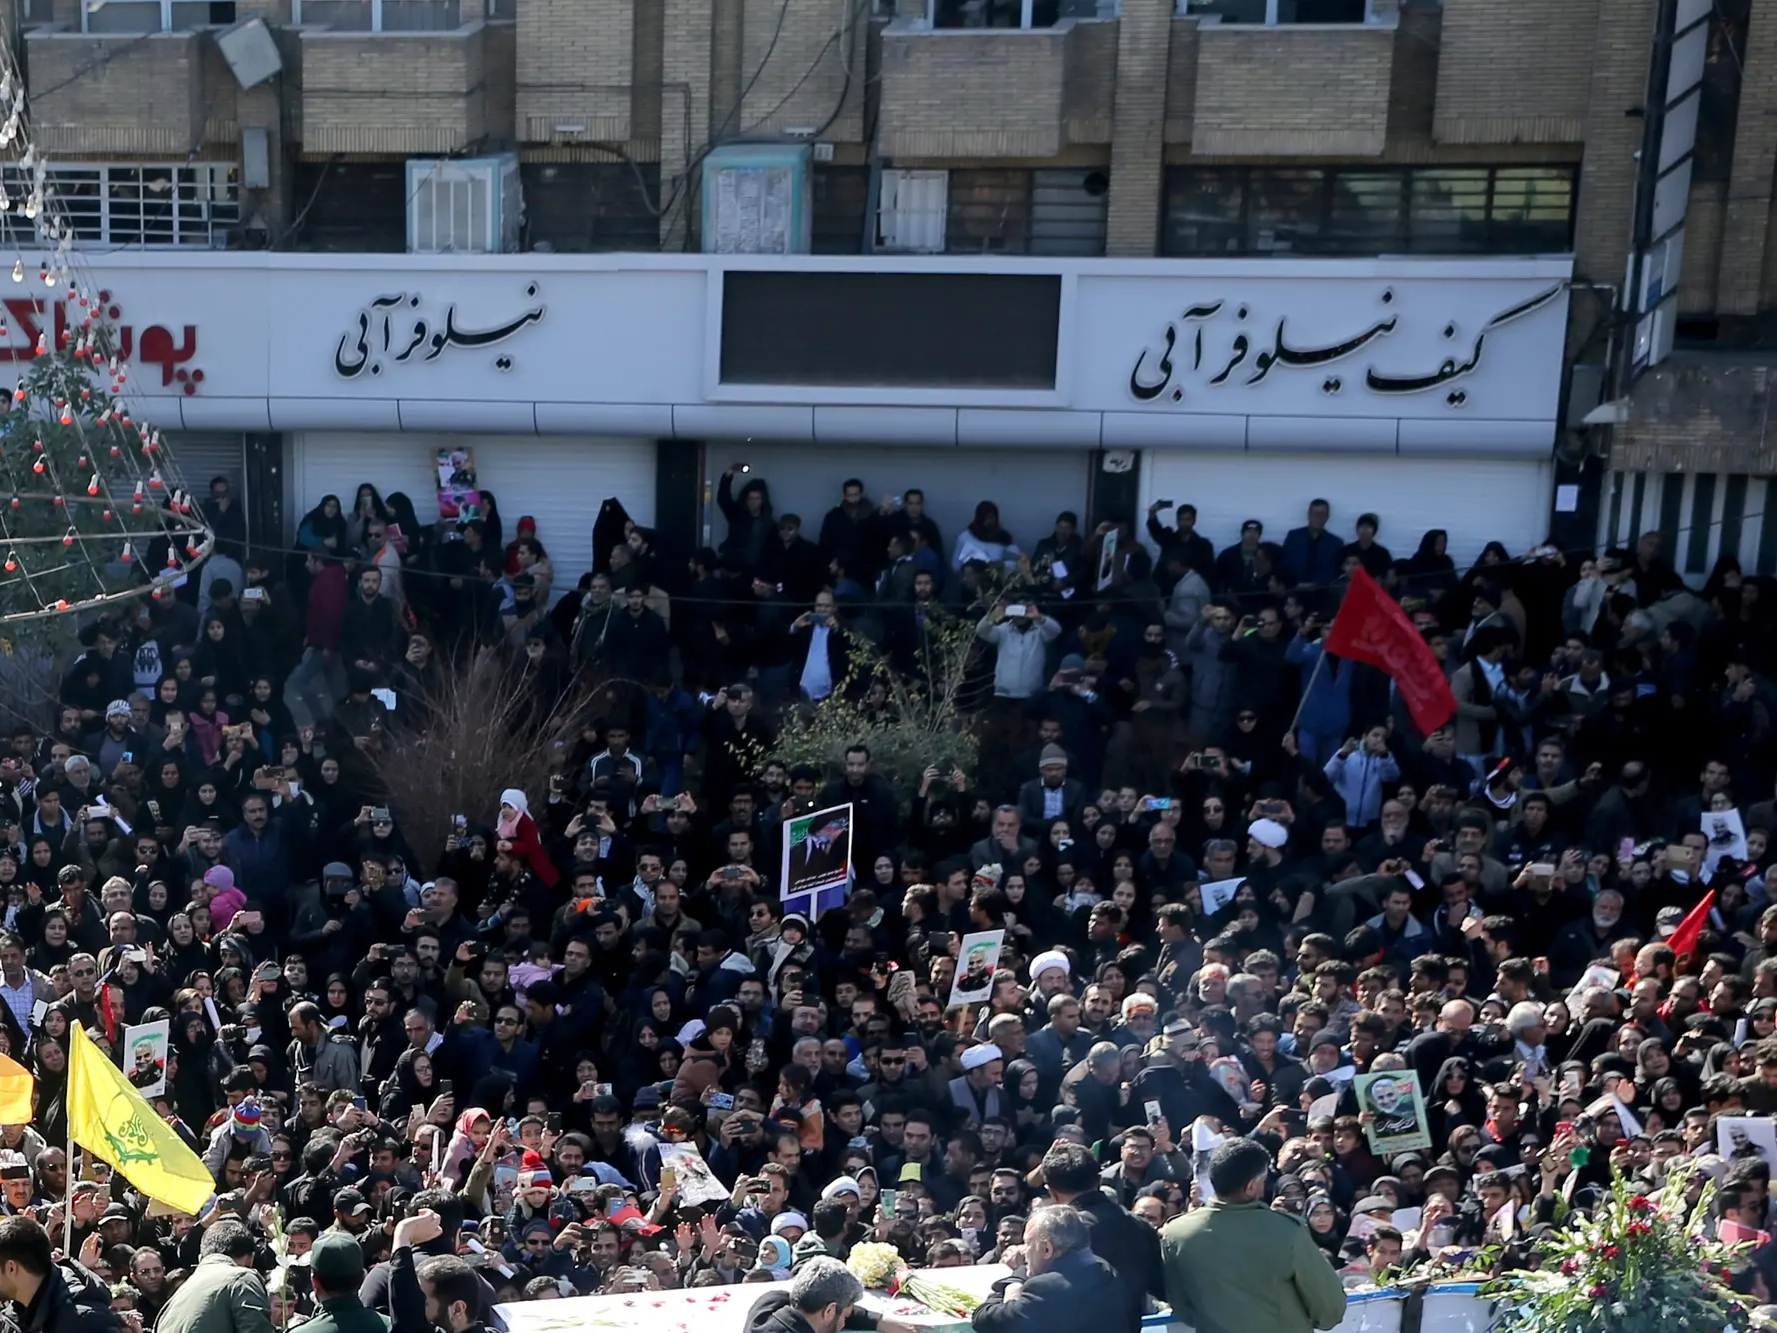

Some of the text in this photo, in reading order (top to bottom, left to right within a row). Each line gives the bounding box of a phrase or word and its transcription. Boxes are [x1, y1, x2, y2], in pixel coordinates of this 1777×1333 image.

[333, 278, 548, 380] نیلوفر آبی
[1128, 280, 1565, 408] کیف نیلوفر آبی
